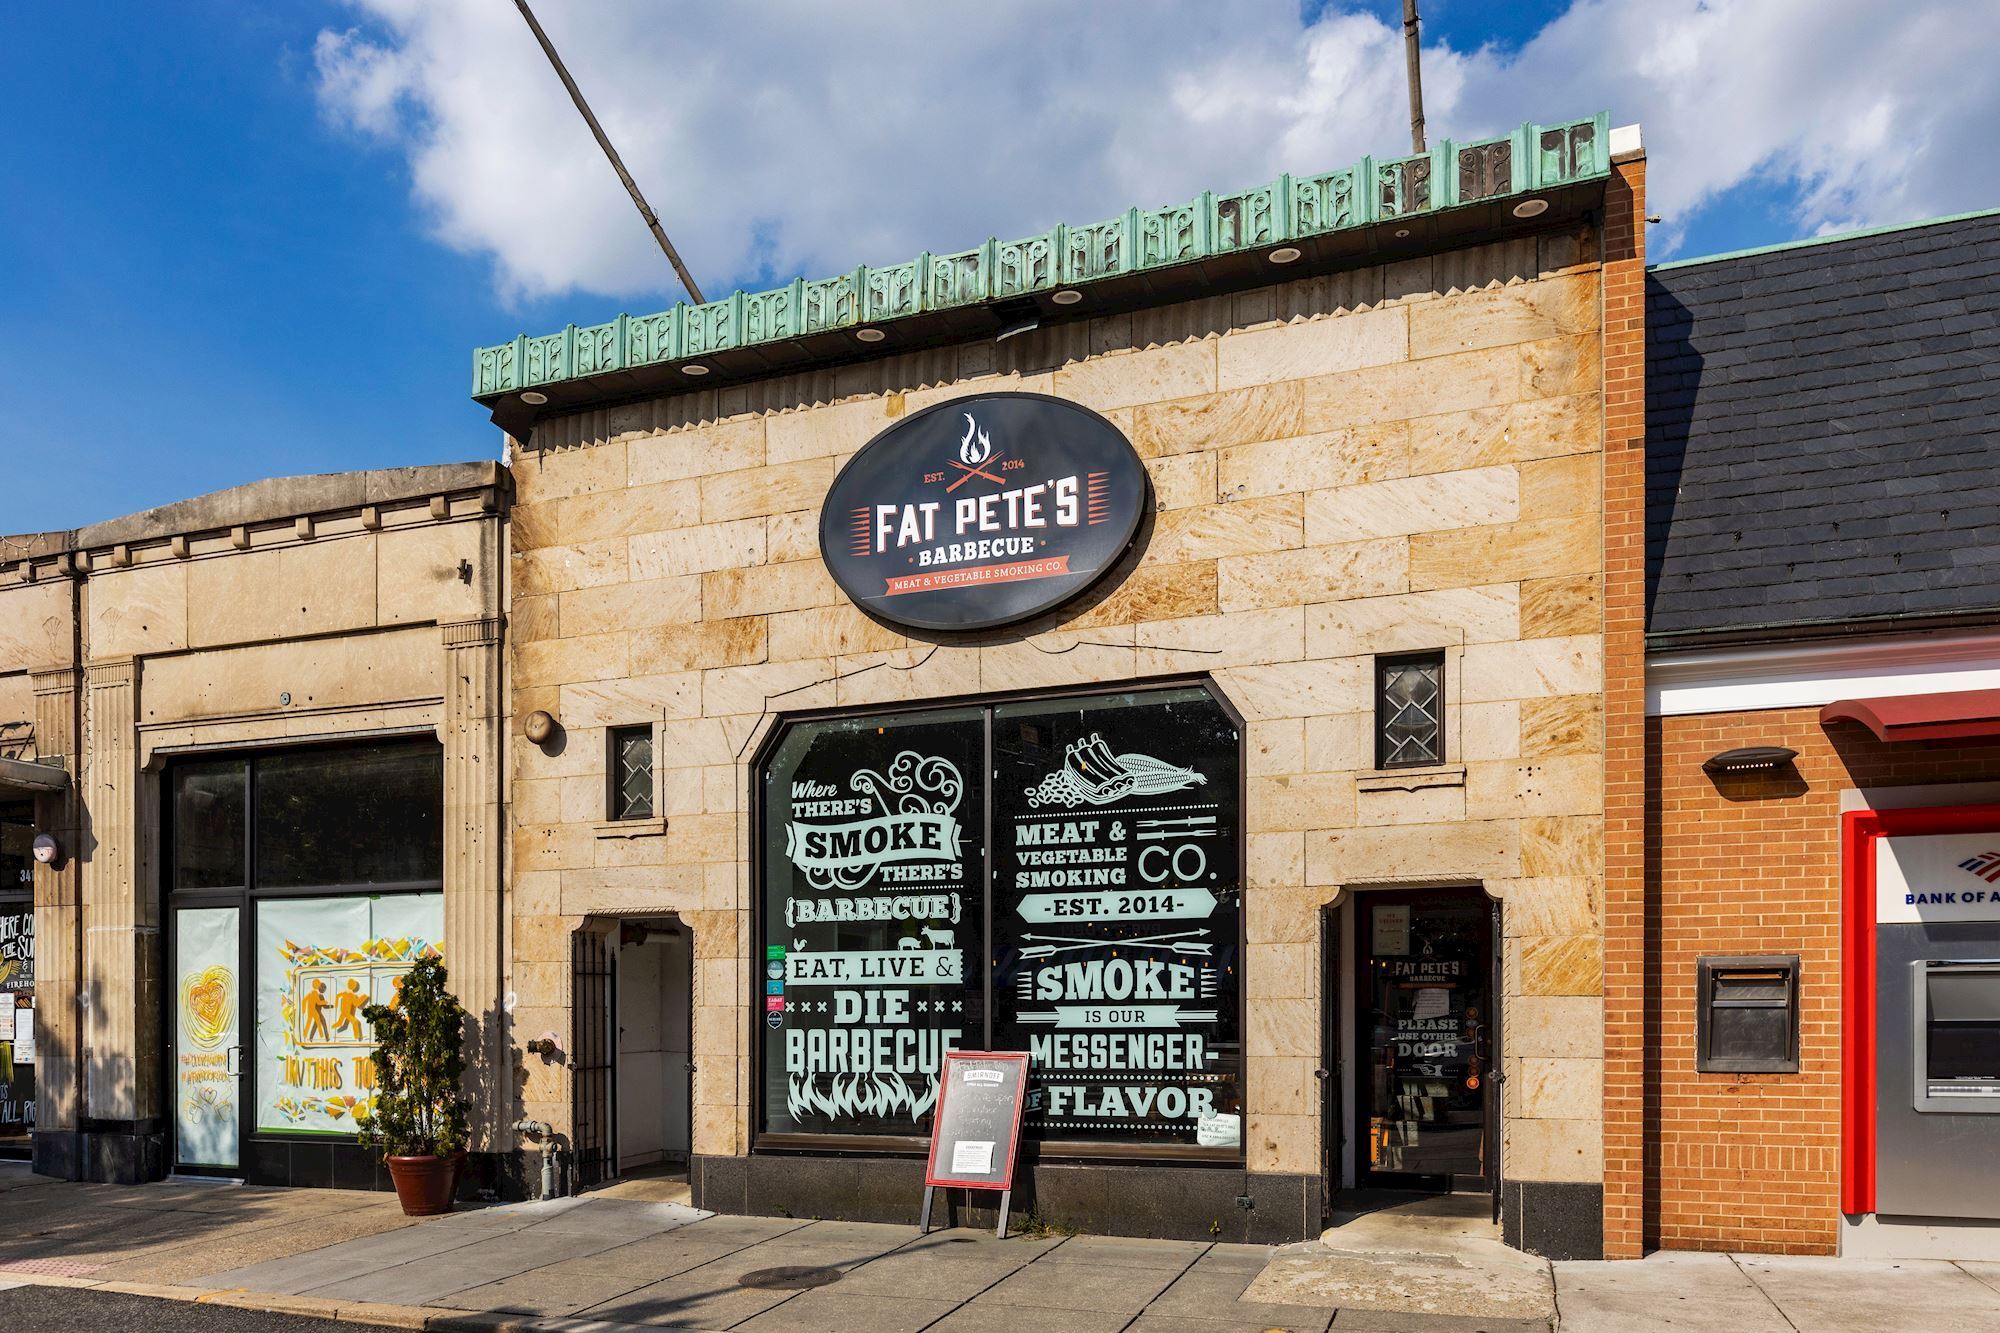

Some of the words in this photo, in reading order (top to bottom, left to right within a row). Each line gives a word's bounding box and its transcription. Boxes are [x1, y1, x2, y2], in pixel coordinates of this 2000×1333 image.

[1002, 459, 1025, 471] 2014
[923, 471, 945, 484] EST.
[876, 502, 940, 553] FAT
[955, 475, 1080, 535] PETE'S
[918, 536, 1034, 567] BARBECUE
[894, 578, 921, 591] MEAT
[923, 576, 932, 587] &
[934, 570, 991, 585] VEGETABLE
[993, 564, 1044, 578] SMOKING
[1046, 561, 1063, 571] CO.
[791, 779, 838, 799] Where
[791, 798, 873, 818] THERE'S
[805, 822, 942, 859] SMOKE
[1015, 821, 1100, 846] MEAT
[1109, 821, 1127, 842] &
[1016, 847, 1128, 866] VEGETABLE
[1138, 843, 1218, 883] CO.
[879, 863, 963, 882] THERE'S
[1015, 868, 1127, 888] SMOKING
[1905, 892, 1956, 905] BANK
[1961, 892, 1985, 903] OF
[793, 958, 850, 981] EAT,
[860, 957, 925, 978] LIVE
[936, 956, 954, 977] &
[1395, 961, 1417, 976] FAT
[1421, 960, 1459, 975] PETE'S
[1036, 958, 1195, 1001] SMOKE
[834, 990, 909, 1024] DIE
[1085, 1010, 1101, 1023] IS
[1109, 1010, 1146, 1023] OUR
[1398, 1019, 1459, 1030] PLEASE
[1398, 1032, 1419, 1040] USE
[1421, 1032, 1458, 1040] OTHER
[1398, 1043, 1459, 1058] DOOR
[967, 1071, 1001, 1080] SMIRNOFF
[1048, 1086, 1218, 1119] FLAVOR
